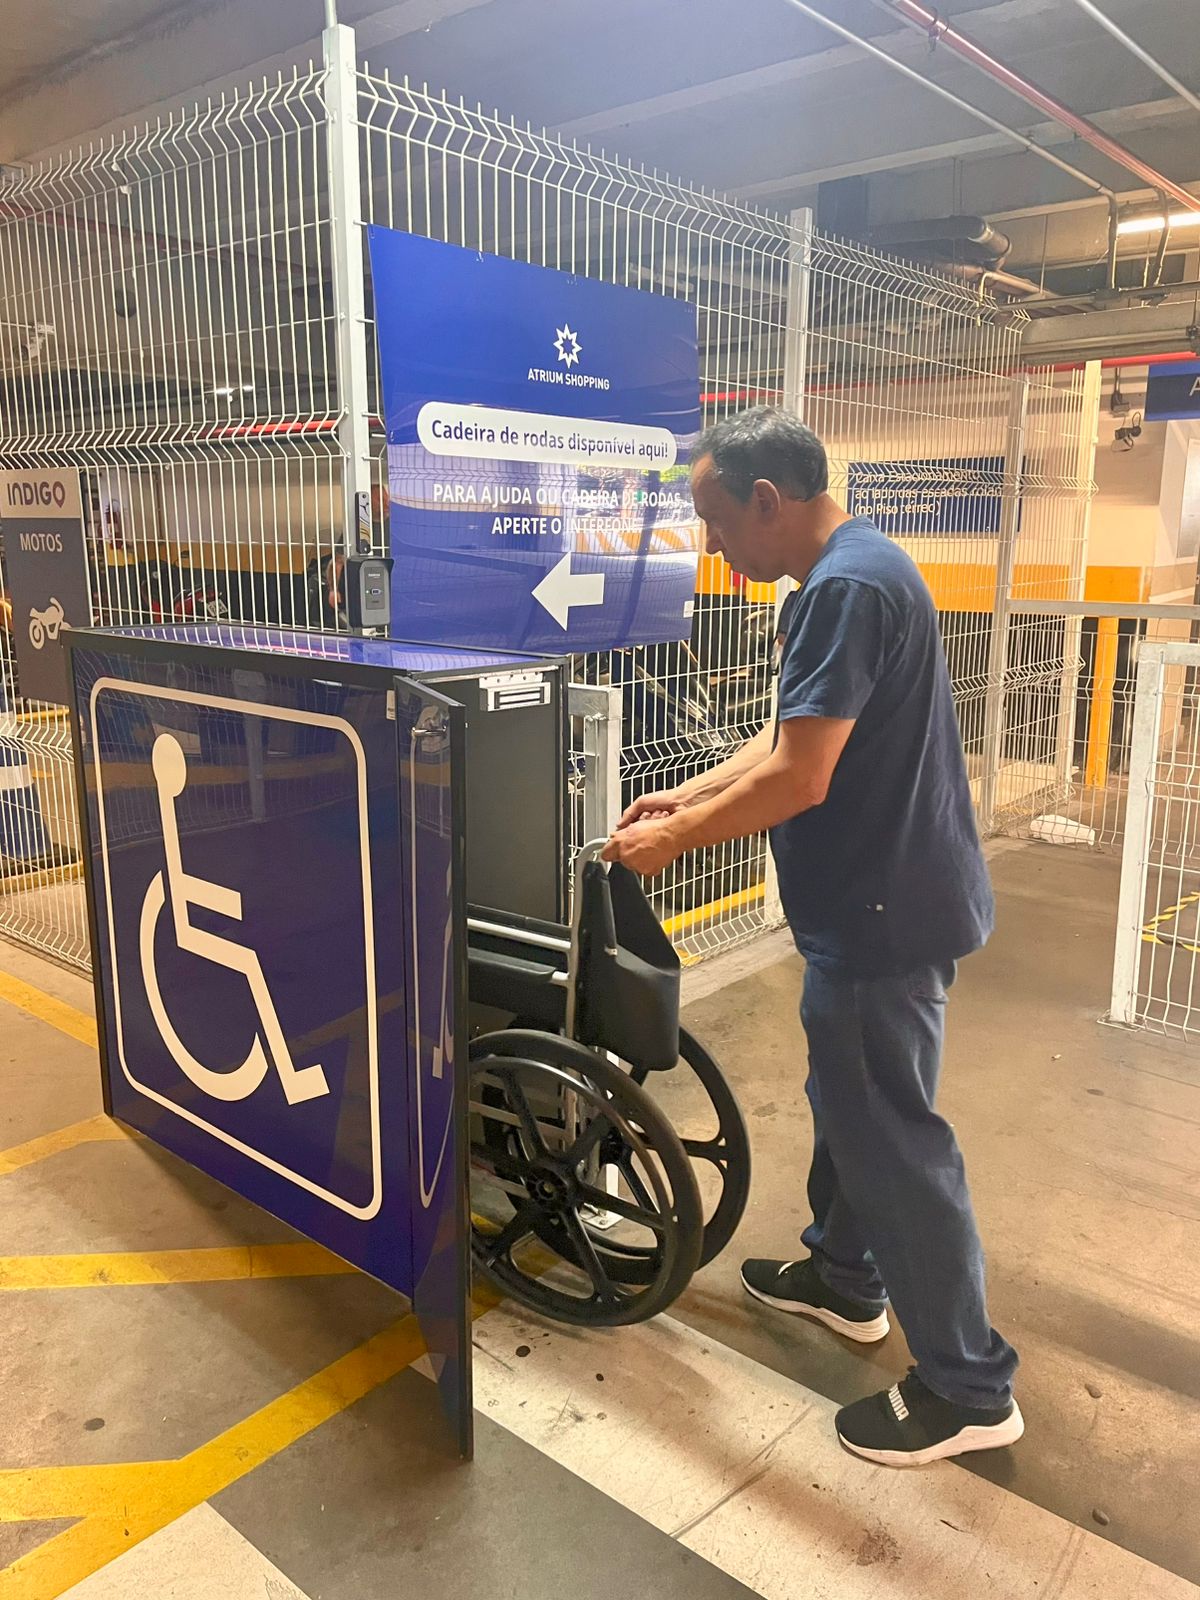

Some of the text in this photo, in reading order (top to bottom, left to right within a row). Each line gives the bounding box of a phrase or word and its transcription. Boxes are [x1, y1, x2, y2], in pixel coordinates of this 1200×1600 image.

[527, 367, 610, 391] ATRIUM SHOPPING
[431, 419, 668, 461] Cadeira de rodas disponível aqui!
[7, 481, 66, 508] INDIGO
[433, 483, 682, 509] PARA AJUDA OU CADEIRA DE RODAS
[971, 484, 1003, 497] rolan
[877, 503, 899, 515] Piso
[491, 516, 640, 535] APERTE O INTERFONE
[20, 533, 63, 552] MOTOS
